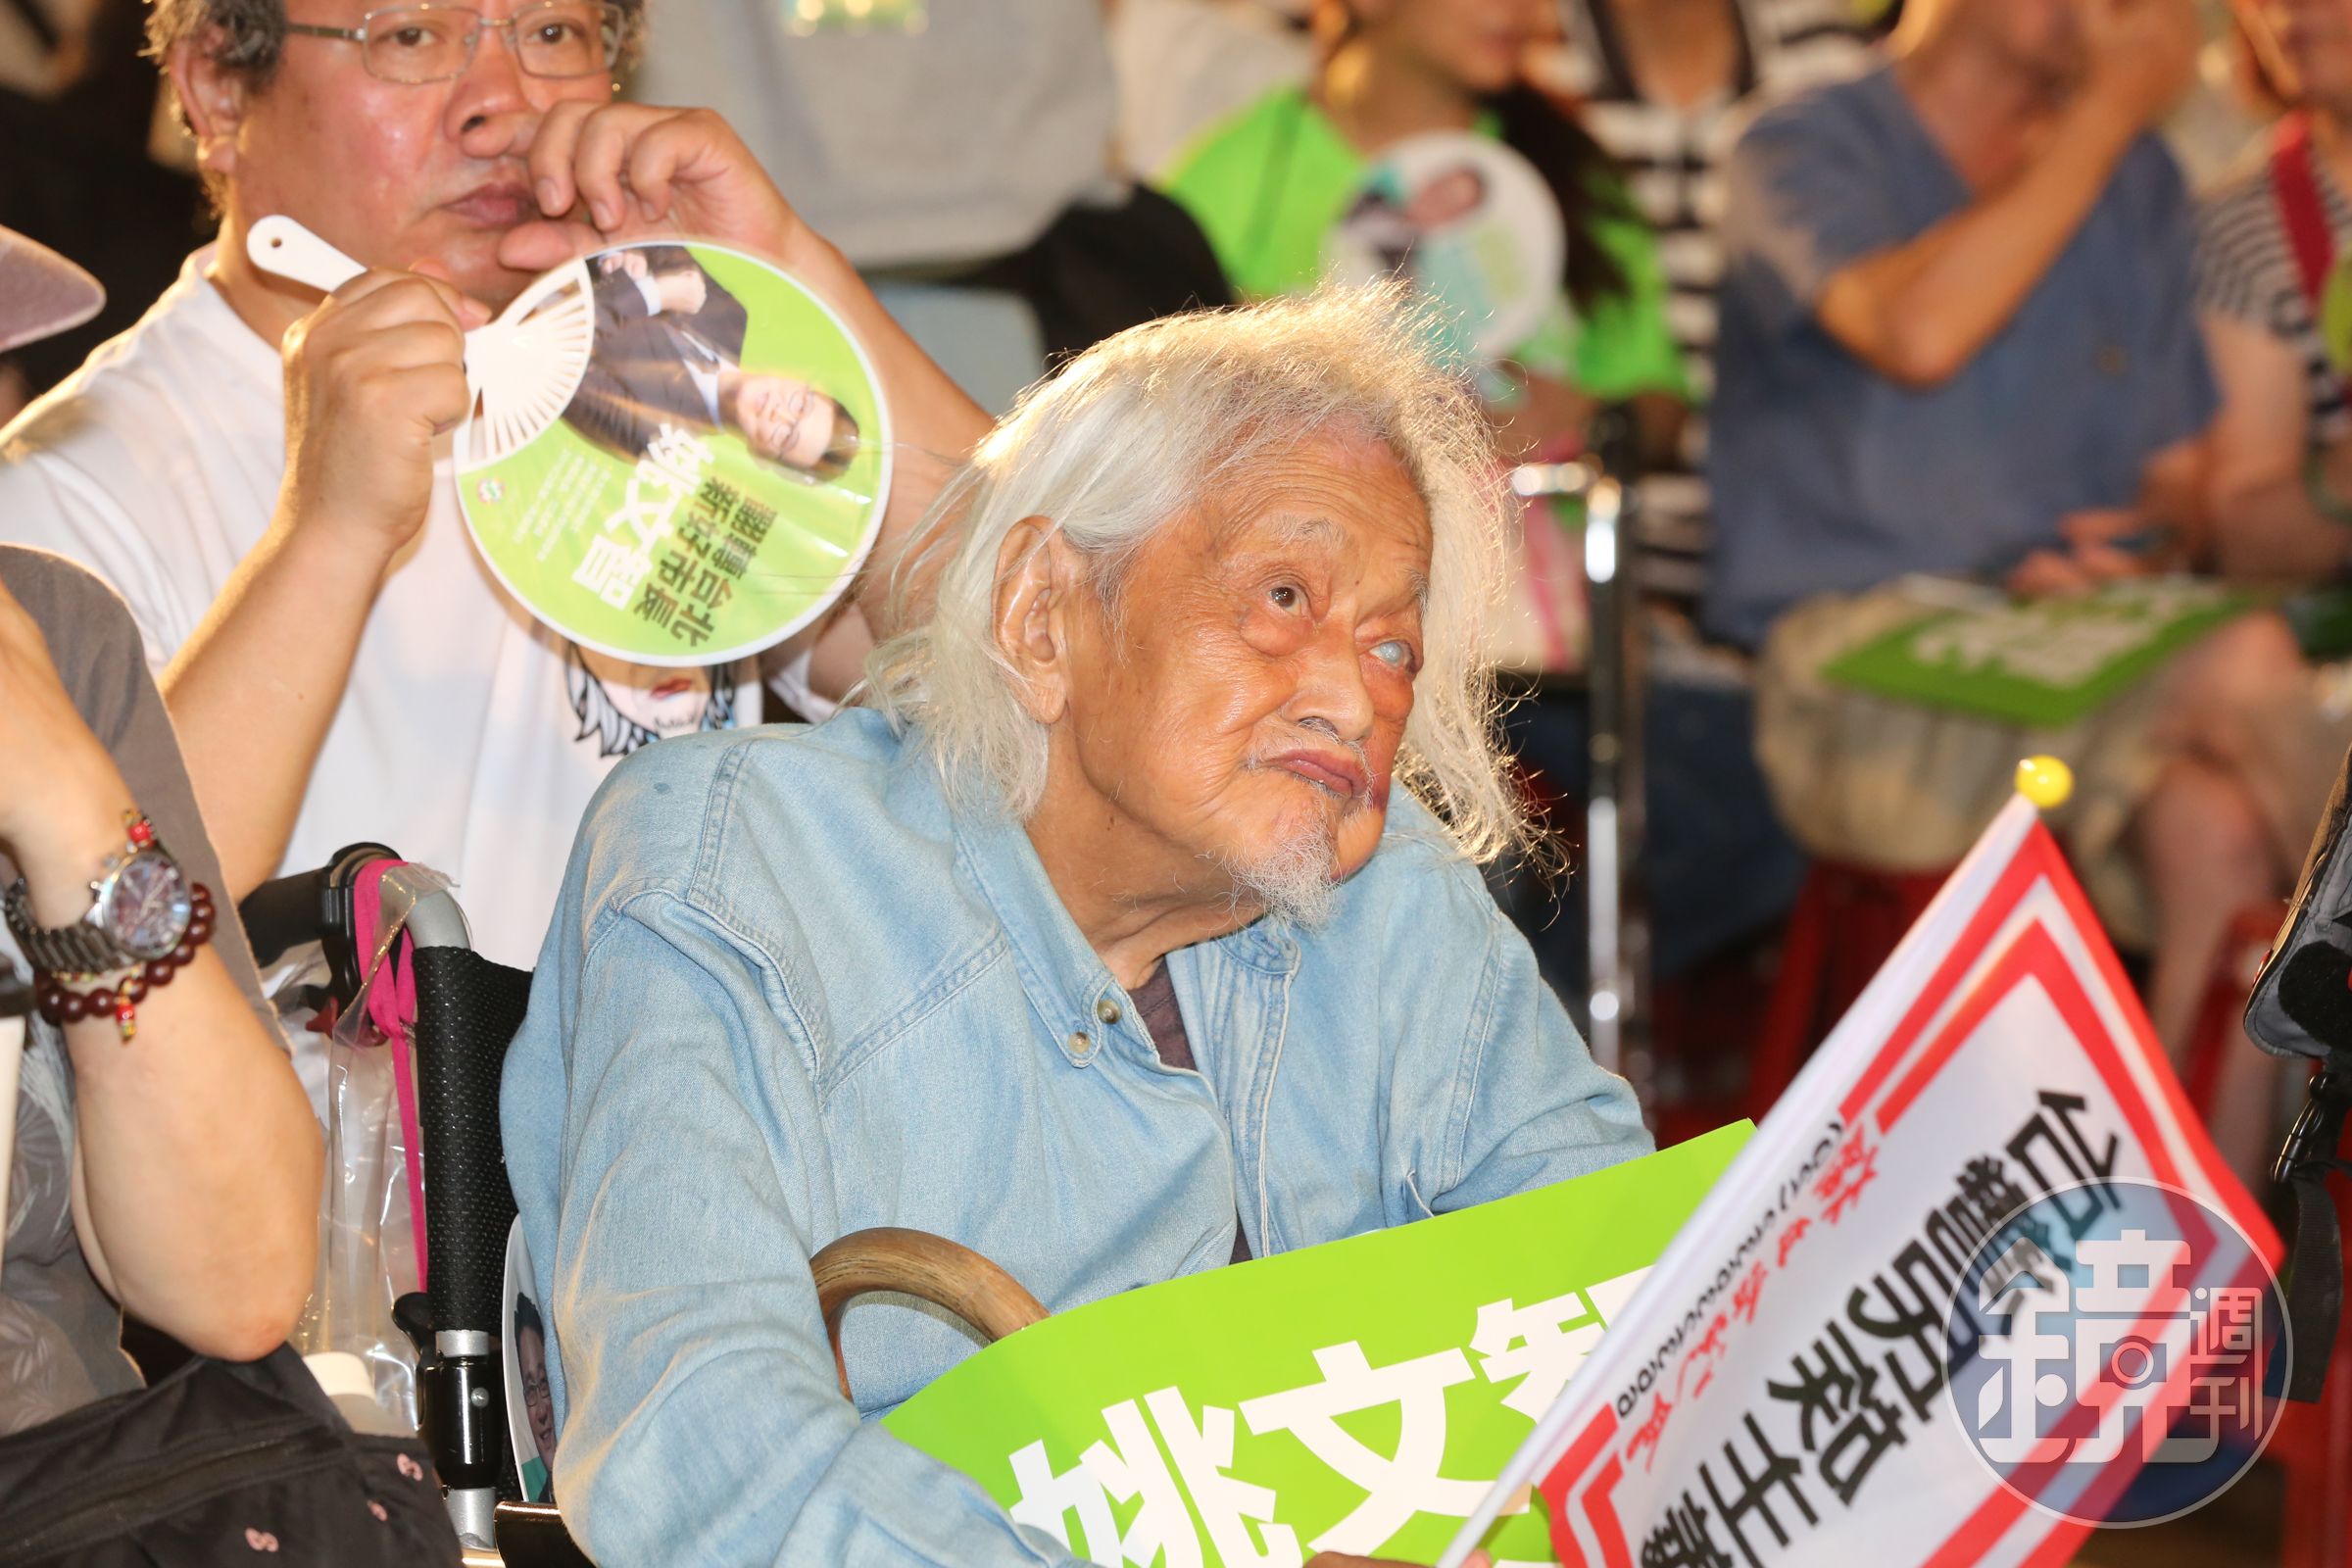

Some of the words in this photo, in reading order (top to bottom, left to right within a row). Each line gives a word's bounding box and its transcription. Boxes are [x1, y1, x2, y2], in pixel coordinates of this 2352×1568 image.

[571, 423, 714, 611] 姚文智
[634, 477, 740, 628] 新好市長
[670, 495, 778, 647] 翻轉台北
